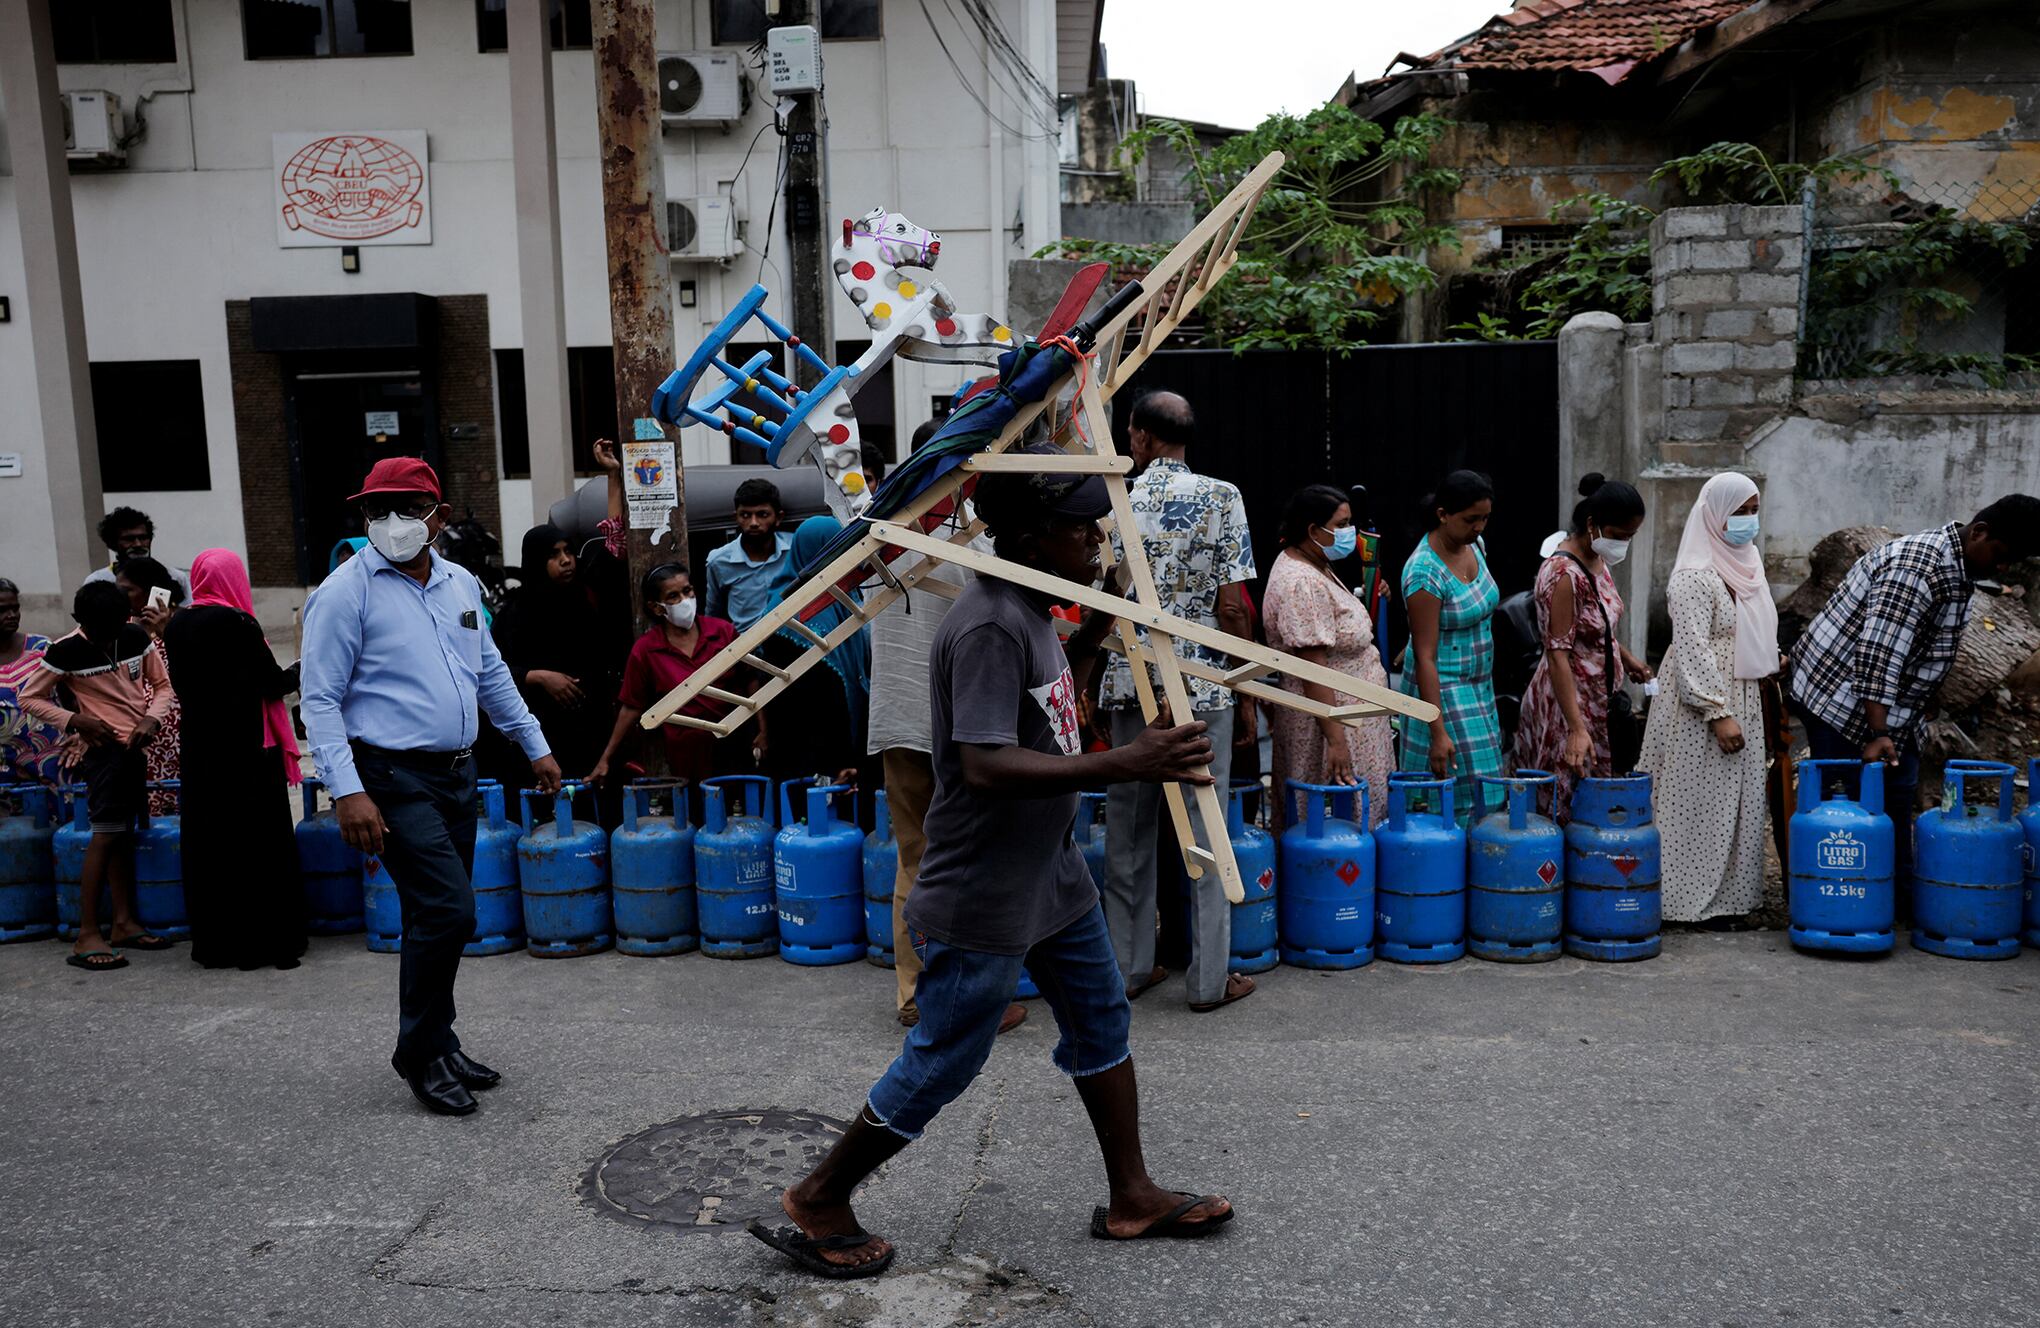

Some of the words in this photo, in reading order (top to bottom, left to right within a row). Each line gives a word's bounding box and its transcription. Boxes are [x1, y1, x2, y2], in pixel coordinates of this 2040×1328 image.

[336, 180, 367, 189] CBEU
[1824, 847, 1859, 857] LITRO
[1828, 856, 1854, 866] GAS
